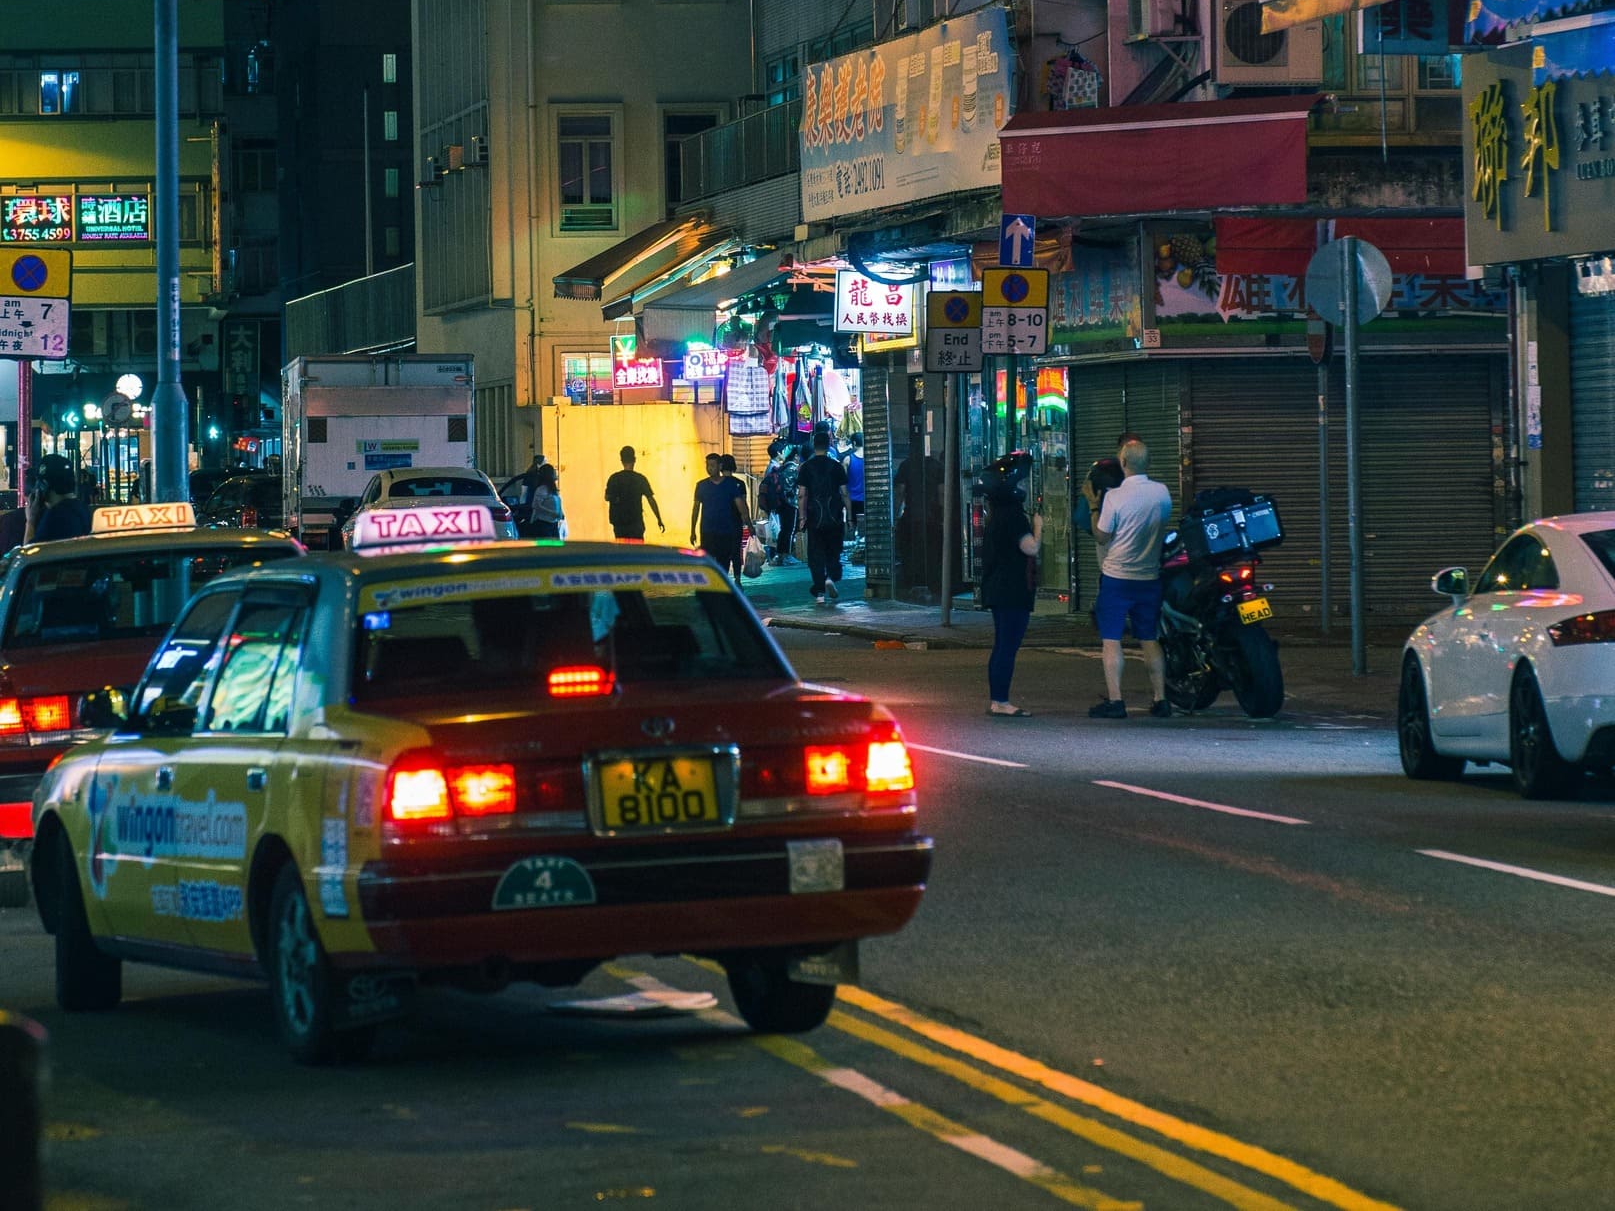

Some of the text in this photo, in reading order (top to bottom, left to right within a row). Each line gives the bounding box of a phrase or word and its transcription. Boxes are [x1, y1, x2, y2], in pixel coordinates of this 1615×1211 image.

[4, 196, 71, 226] 環球
[0, 308, 25, 320] 上午
[41, 303, 53, 320] 7
[986, 318, 1004, 328] 上午
[0, 339, 23, 351] 午夜
[40, 334, 64, 351] 12
[944, 333, 969, 346] End
[986, 340, 1004, 349] 下午
[988, 333, 1001, 341] pm
[937, 350, 972, 367] 終止
[101, 506, 188, 527] TAXI
[371, 508, 482, 539] TAXI
[1241, 606, 1272, 622] HEAD
[633, 763, 682, 792] KA
[618, 791, 706, 825] 8100
[533, 870, 554, 890] 4
[514, 890, 575, 905] SEATS
